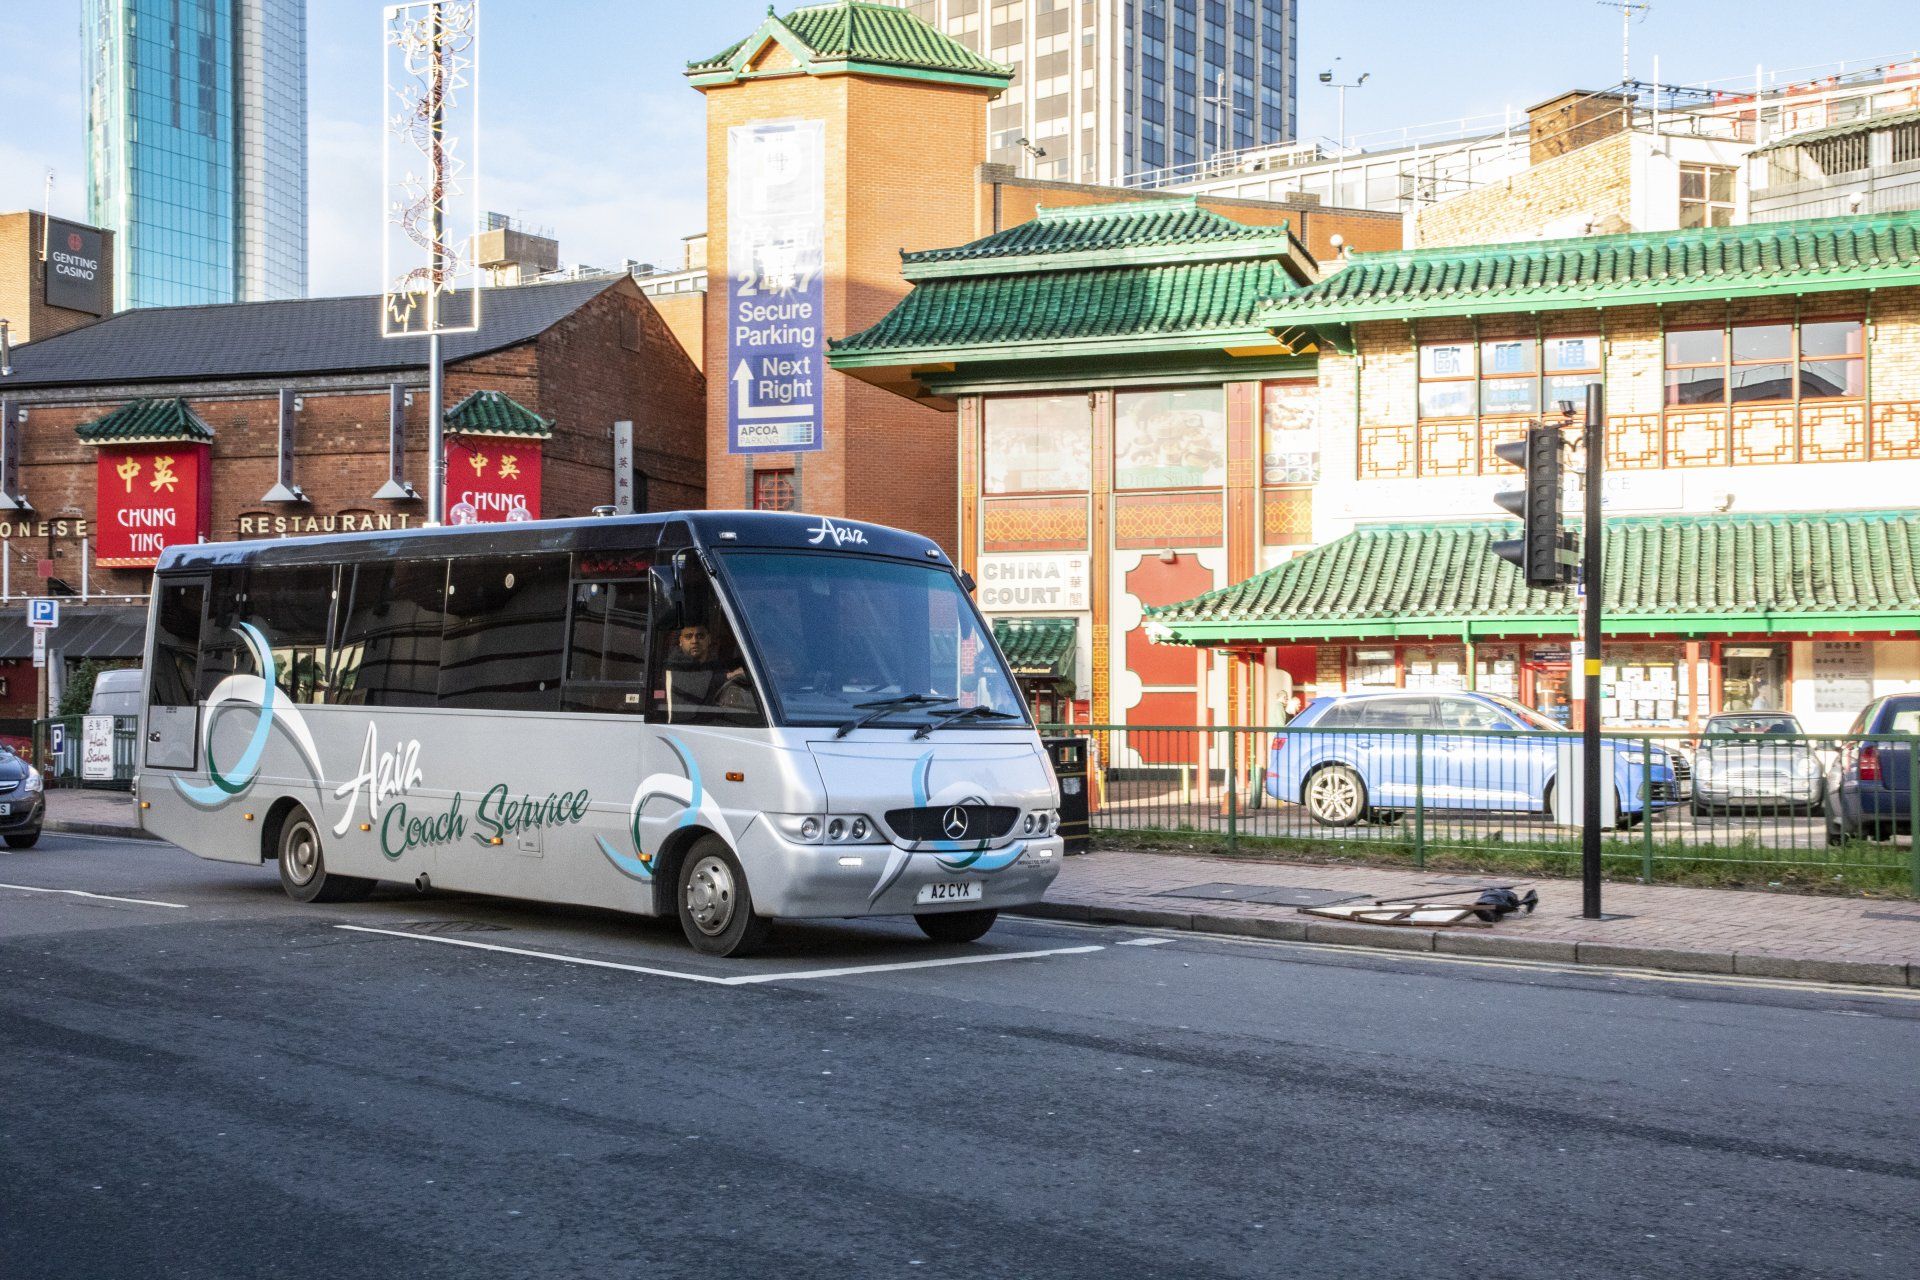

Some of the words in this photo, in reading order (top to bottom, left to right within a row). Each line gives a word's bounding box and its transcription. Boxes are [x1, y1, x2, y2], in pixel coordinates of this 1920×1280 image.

[53, 251, 98, 270] GENTING
[56, 264, 94, 280] CASINO
[738, 301, 813, 322] Secure
[736, 324, 815, 348] Parking
[762, 356, 811, 377] Next
[759, 379, 813, 404] Right
[740, 425, 779, 436] APCOA
[739, 436, 779, 445] PARKING
[116, 456, 179, 493] 中英
[469, 453, 521, 480] 中英
[461, 491, 526, 512] CHUNG
[117, 508, 176, 527] CHUNG
[240, 513, 410, 534] RESTAURANT
[807, 517, 869, 546] Aziz
[129, 533, 164, 552] YING
[983, 562, 1061, 580] CHINA
[982, 587, 1061, 605] COURT
[36, 602, 51, 619] P
[53, 730, 62, 749] P
[89, 734, 108, 747] Hair
[333, 720, 423, 835] Aziz
[381, 791, 468, 859] Coach
[472, 783, 591, 845] Service
[931, 884, 946, 899] A2
[948, 882, 970, 898] CYX
